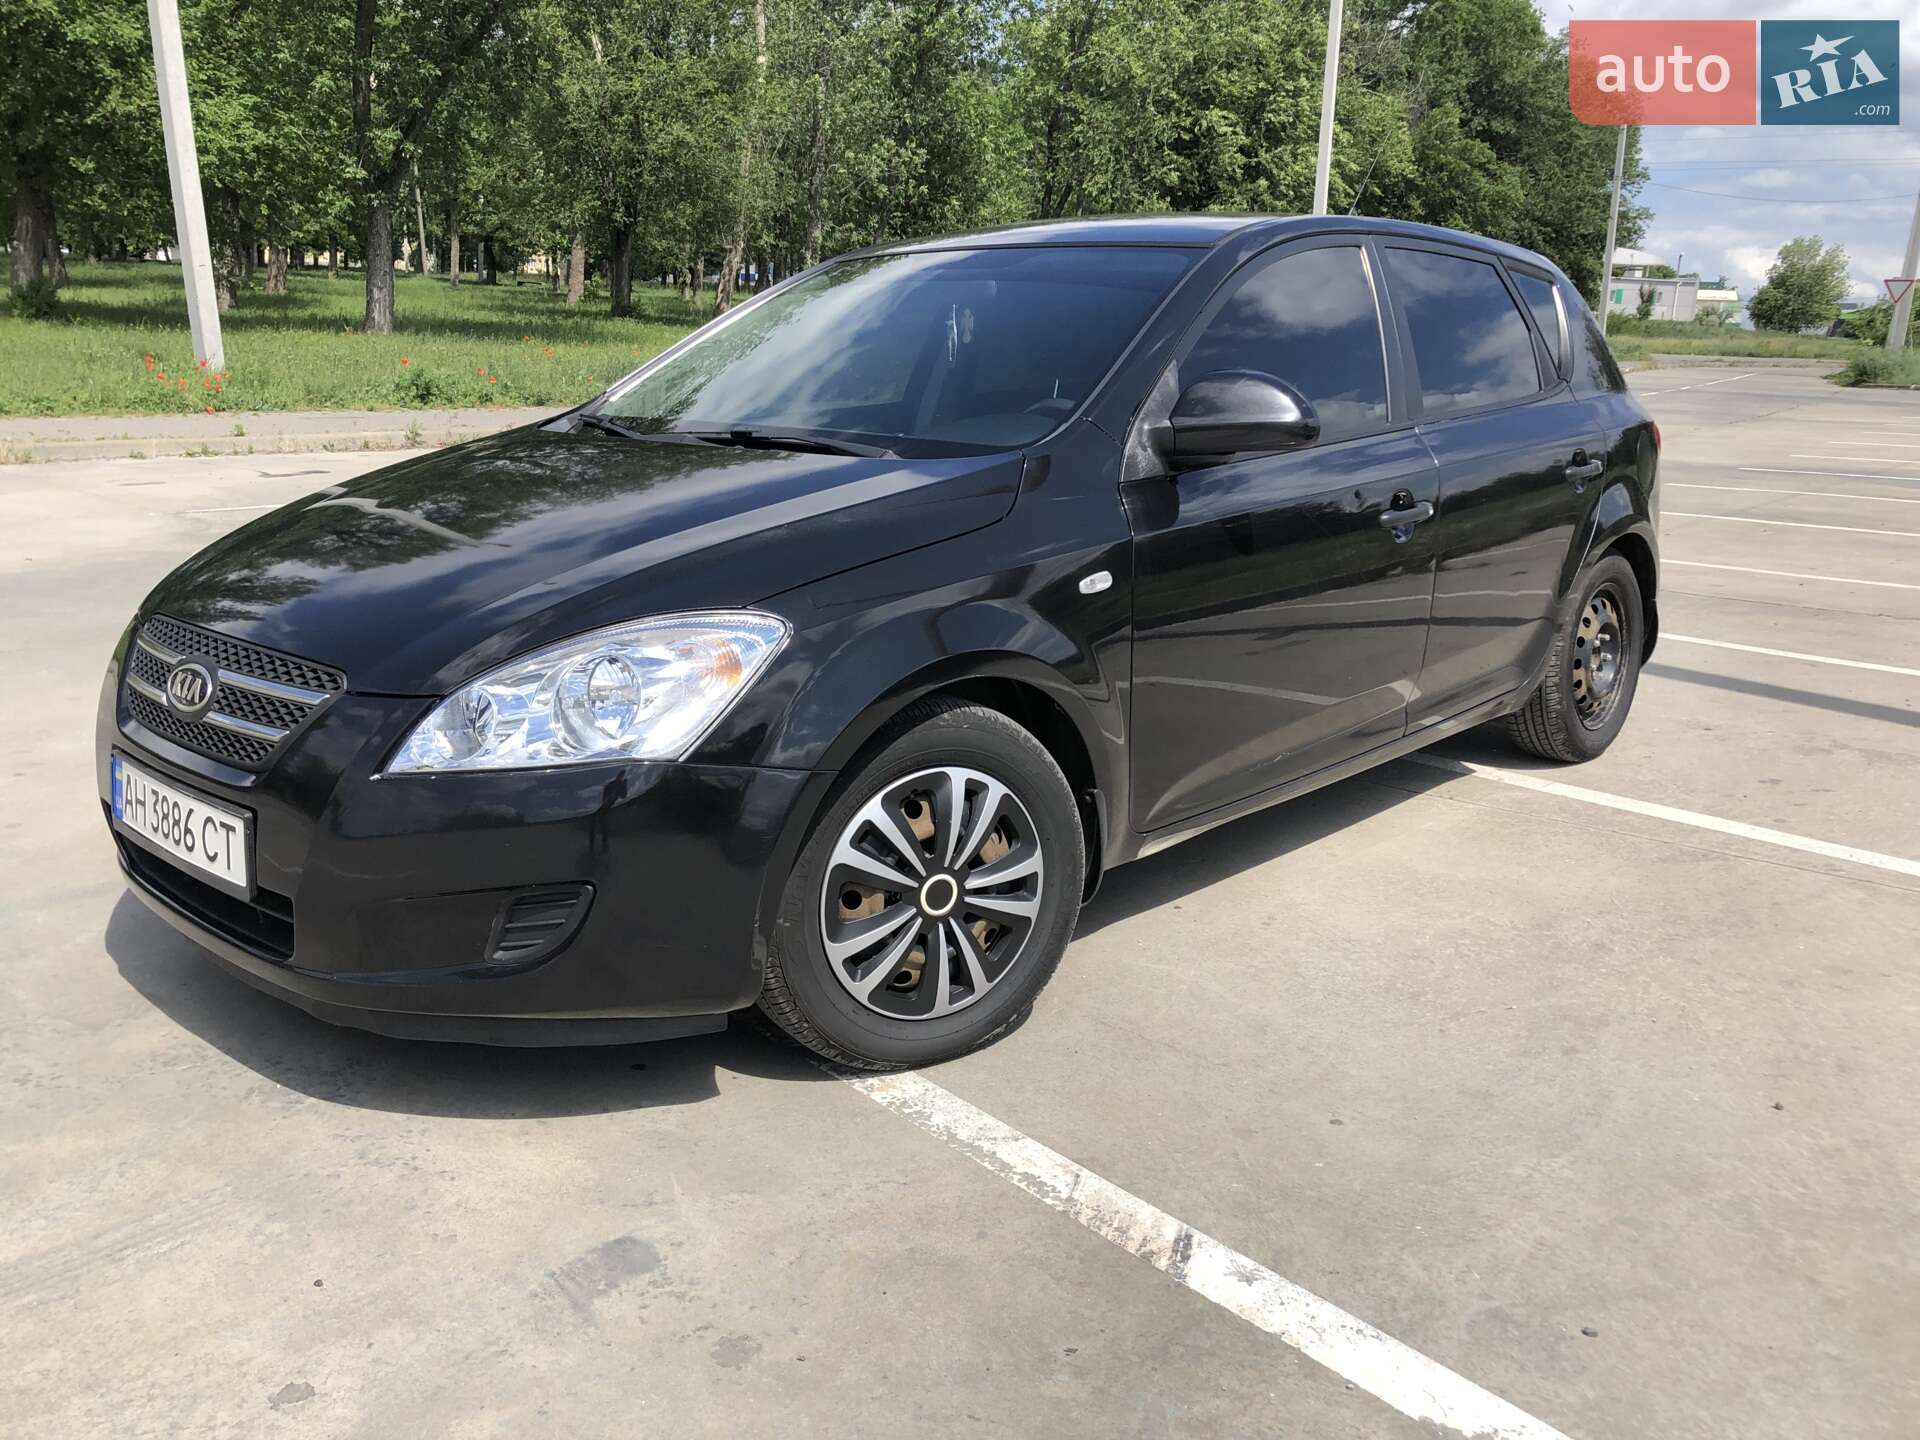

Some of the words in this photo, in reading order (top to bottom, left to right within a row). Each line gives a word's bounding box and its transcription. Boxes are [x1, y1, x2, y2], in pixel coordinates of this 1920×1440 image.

[172, 670, 202, 704] KIA
[124, 773, 147, 828] AH
[150, 790, 196, 853] 3886
[202, 815, 237, 871] CT
